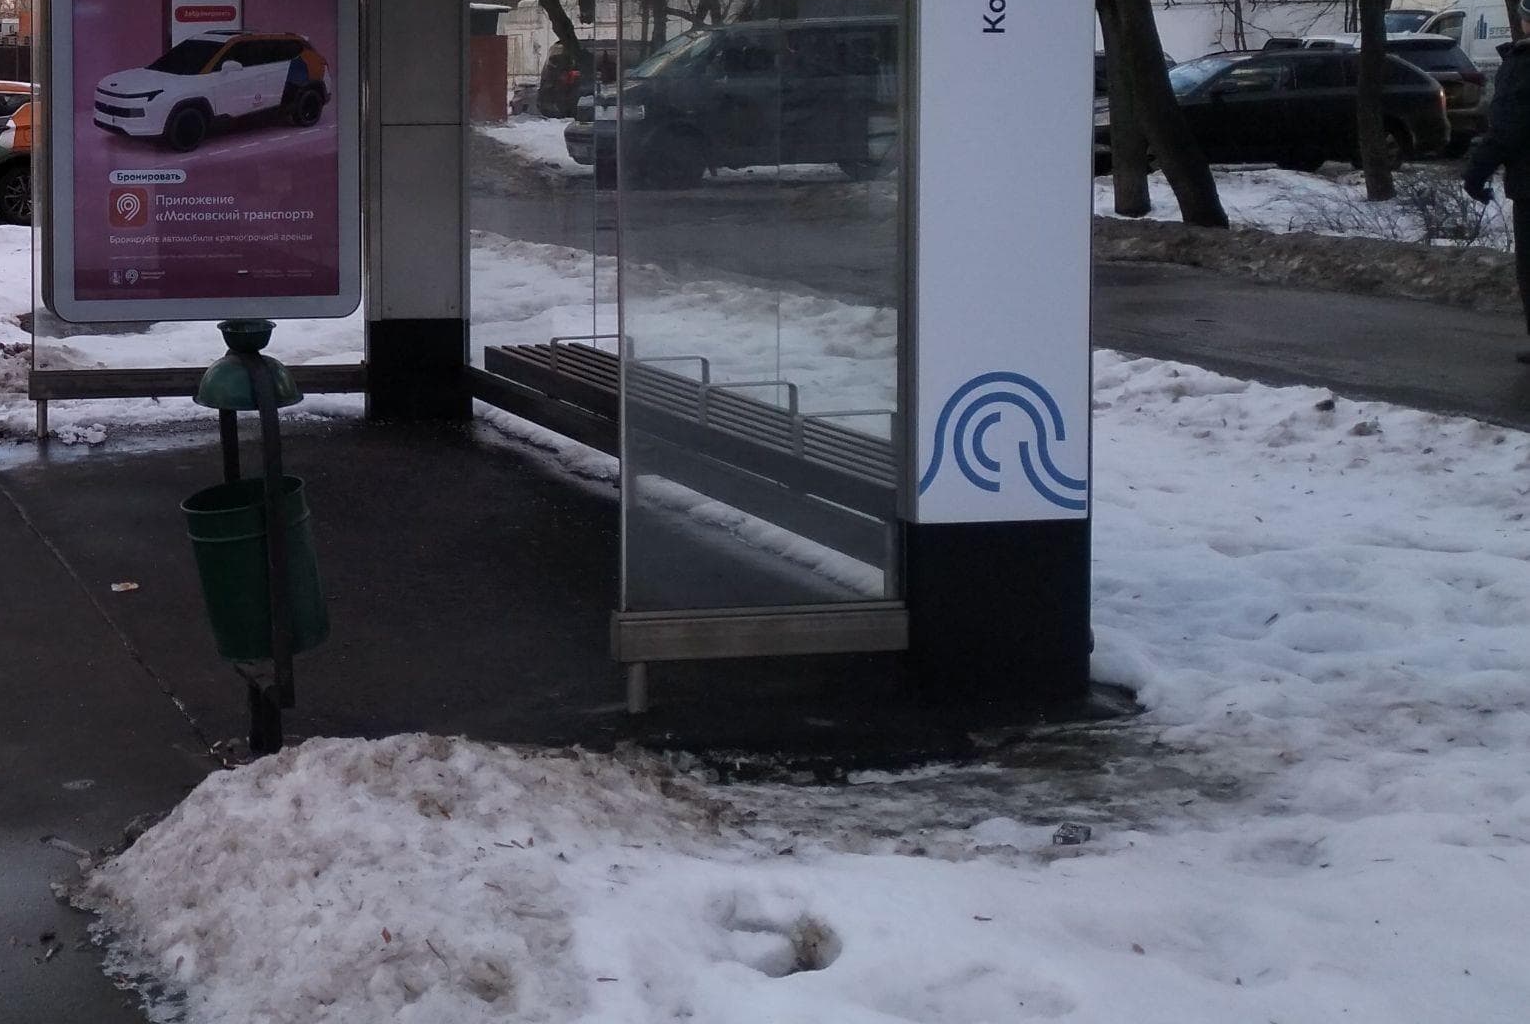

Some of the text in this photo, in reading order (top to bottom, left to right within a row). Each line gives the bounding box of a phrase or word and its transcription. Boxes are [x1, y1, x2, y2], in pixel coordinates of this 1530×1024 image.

[116, 171, 181, 183] Бронировать
[155, 194, 235, 207] Приложение
[155, 210, 314, 222] «Московский транспорт»
